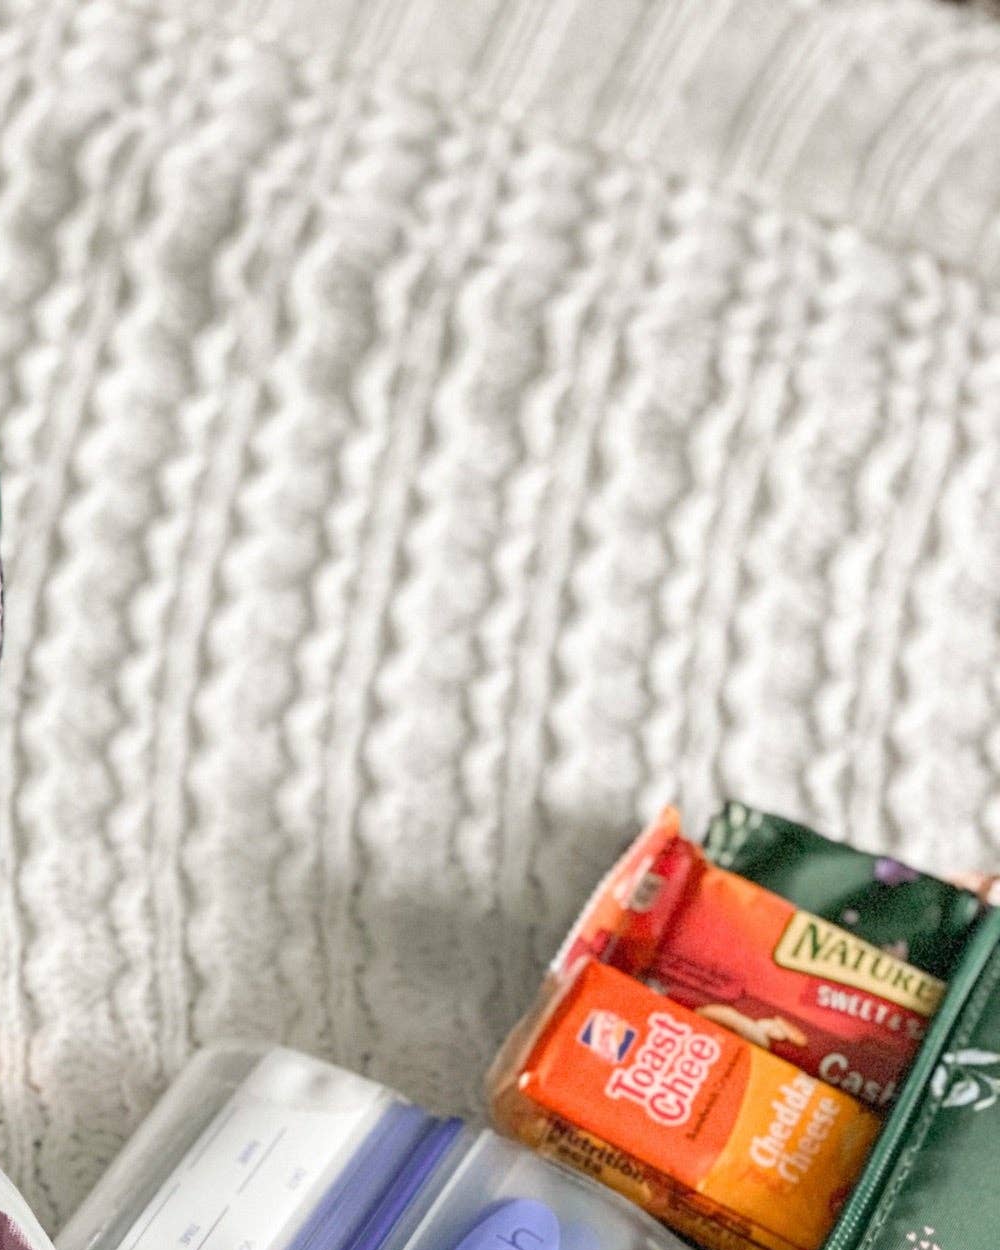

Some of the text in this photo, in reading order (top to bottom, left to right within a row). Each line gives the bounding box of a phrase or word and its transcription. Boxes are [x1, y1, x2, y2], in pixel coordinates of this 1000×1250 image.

[611, 1017, 686, 1100] Toast
[649, 1038, 715, 1121] Chee
[777, 1097, 840, 1184] Cheese
